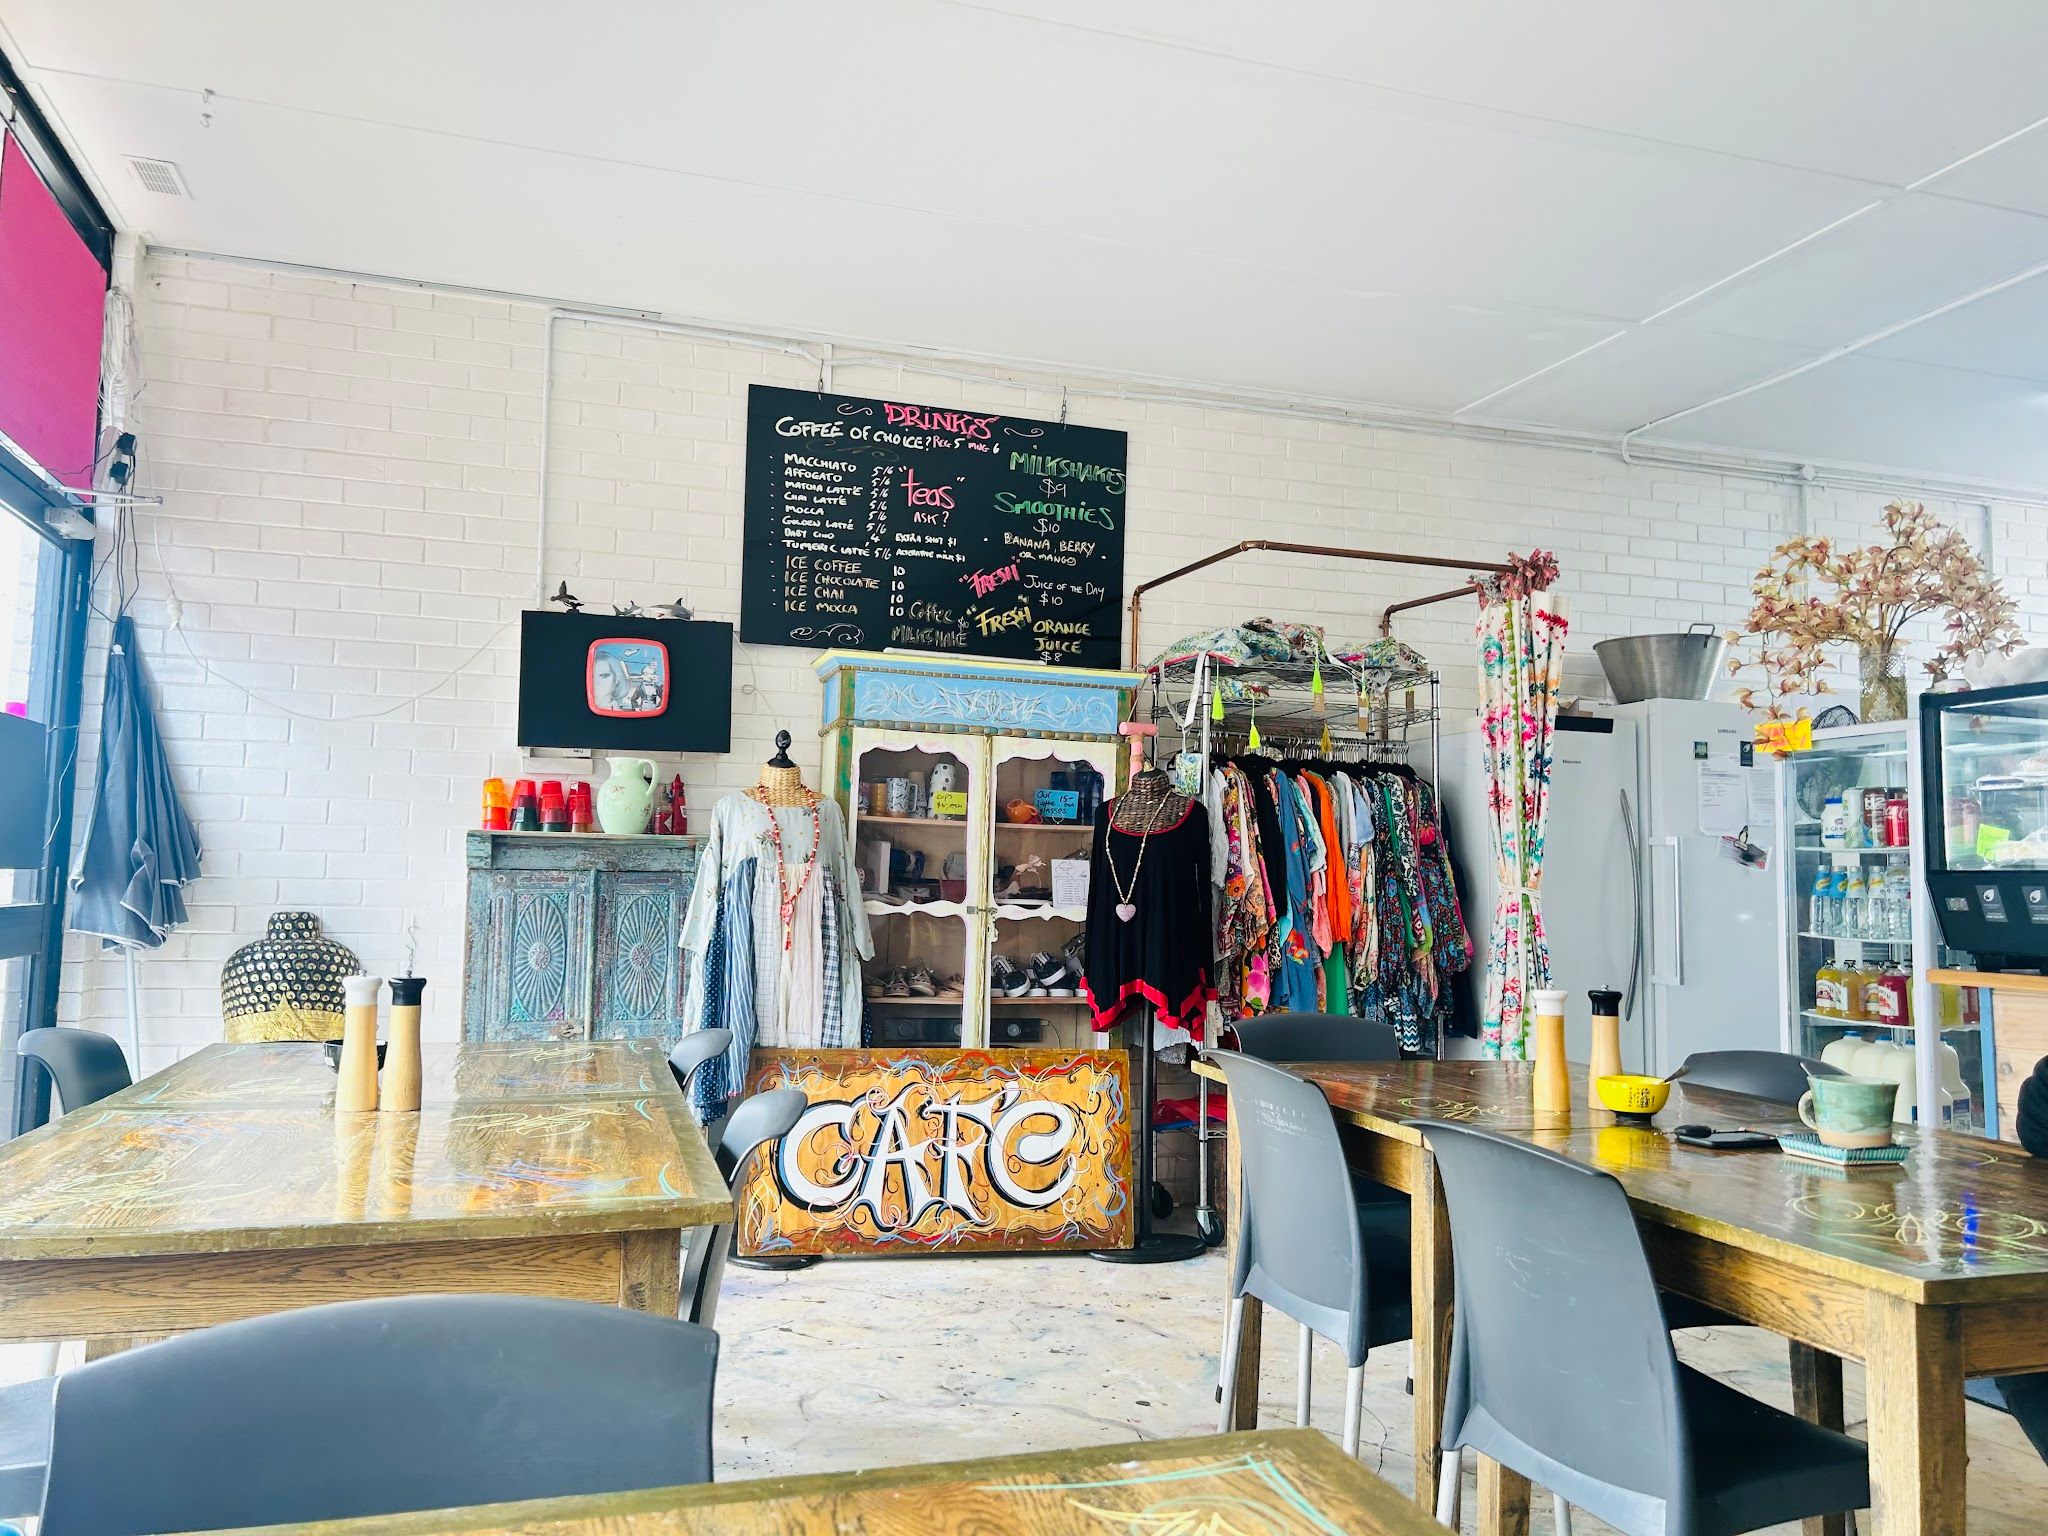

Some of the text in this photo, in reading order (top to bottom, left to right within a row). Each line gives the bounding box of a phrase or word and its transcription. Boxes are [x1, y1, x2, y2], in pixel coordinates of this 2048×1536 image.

[775, 417, 844, 437] COFFEE
[850, 425, 872, 441] OF
[954, 438, 965, 449] 5
[993, 442, 1000, 454] 6
[784, 453, 894, 477] MACCHIATO 5/6
[784, 467, 891, 487] AFFOGATO 5/6
[870, 488, 889, 499] 5/6
[1039, 478, 1067, 499] $9
[785, 504, 887, 521] MOCCA 5/6
[869, 500, 888, 511] 5/6
[866, 522, 887, 535] 5/6
[1033, 518, 1061, 537] $10
[870, 533, 880, 543] 4
[781, 539, 838, 553] TUMERIC
[874, 547, 893, 560] 5/6
[1059, 540, 1096, 558] BERRY
[786, 554, 906, 577] ICE COFFEE 10
[1019, 551, 1077, 567] OR MANGO
[784, 571, 905, 592] ICE CHOCOLATE 10
[1024, 574, 1053, 590] JUICE
[1056, 583, 1067, 591] OF
[1070, 585, 1083, 594] THE
[784, 584, 904, 605] ICE CHAI 10
[784, 600, 905, 617] ICE MOCCA 10
[1033, 620, 1093, 637] ORANGE
[1034, 637, 1083, 655] JUICE
